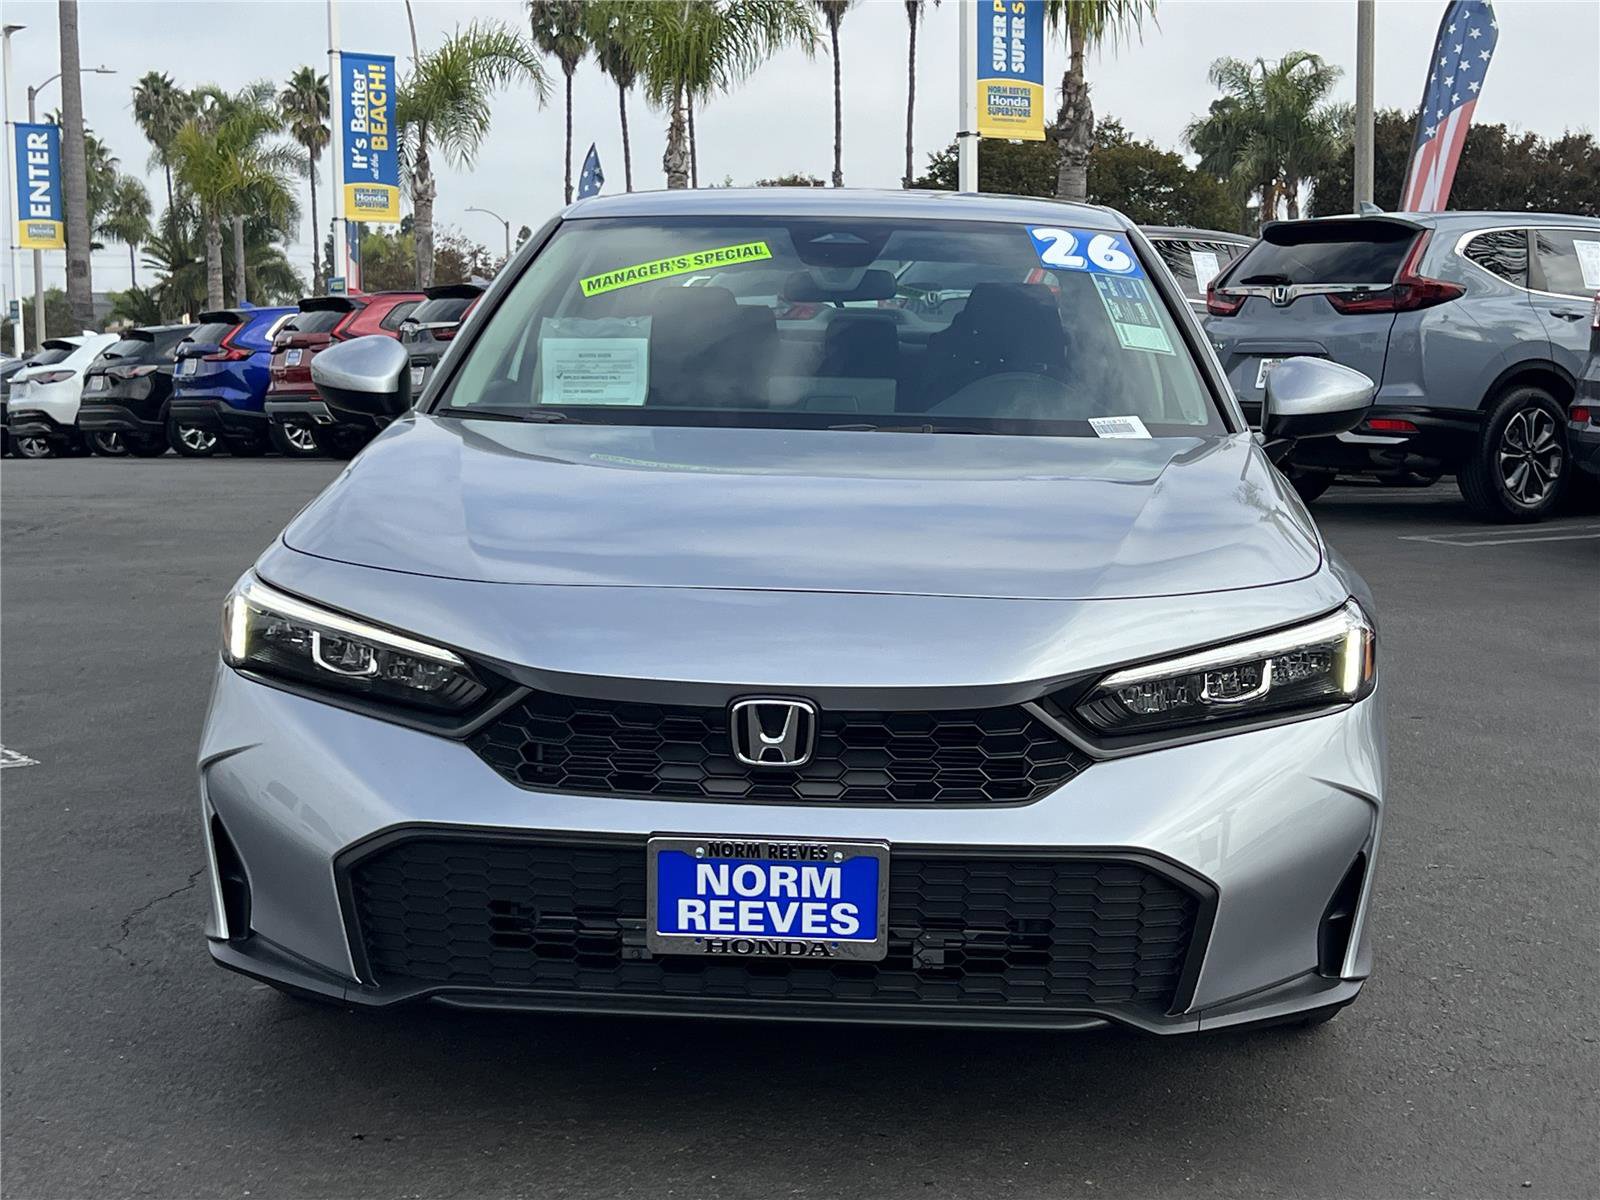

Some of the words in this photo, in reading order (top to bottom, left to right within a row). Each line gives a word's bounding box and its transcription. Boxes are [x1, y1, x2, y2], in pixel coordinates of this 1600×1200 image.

[993, 15, 1007, 72] SUPER
[1011, 17, 1025, 73] SUPER
[351, 69, 367, 132] Better
[368, 64, 388, 151] BEACH!
[988, 85, 1008, 95] NORM
[1009, 87, 1031, 96] REEVES
[990, 95, 1029, 107] Honda
[988, 106, 1031, 117] SUPERSTORE
[351, 138, 368, 169] It's
[27, 132, 51, 217] ENTER
[356, 193, 387, 202] Honda
[586, 257, 689, 292] MANAGER'S
[694, 244, 765, 266] SPECIAL
[1032, 228, 1135, 273] 26
[707, 842, 761, 859] NORM
[768, 844, 828, 860] REEVES
[697, 863, 842, 899] NORM
[678, 899, 860, 935] REEVES
[704, 937, 834, 957] HONDA
